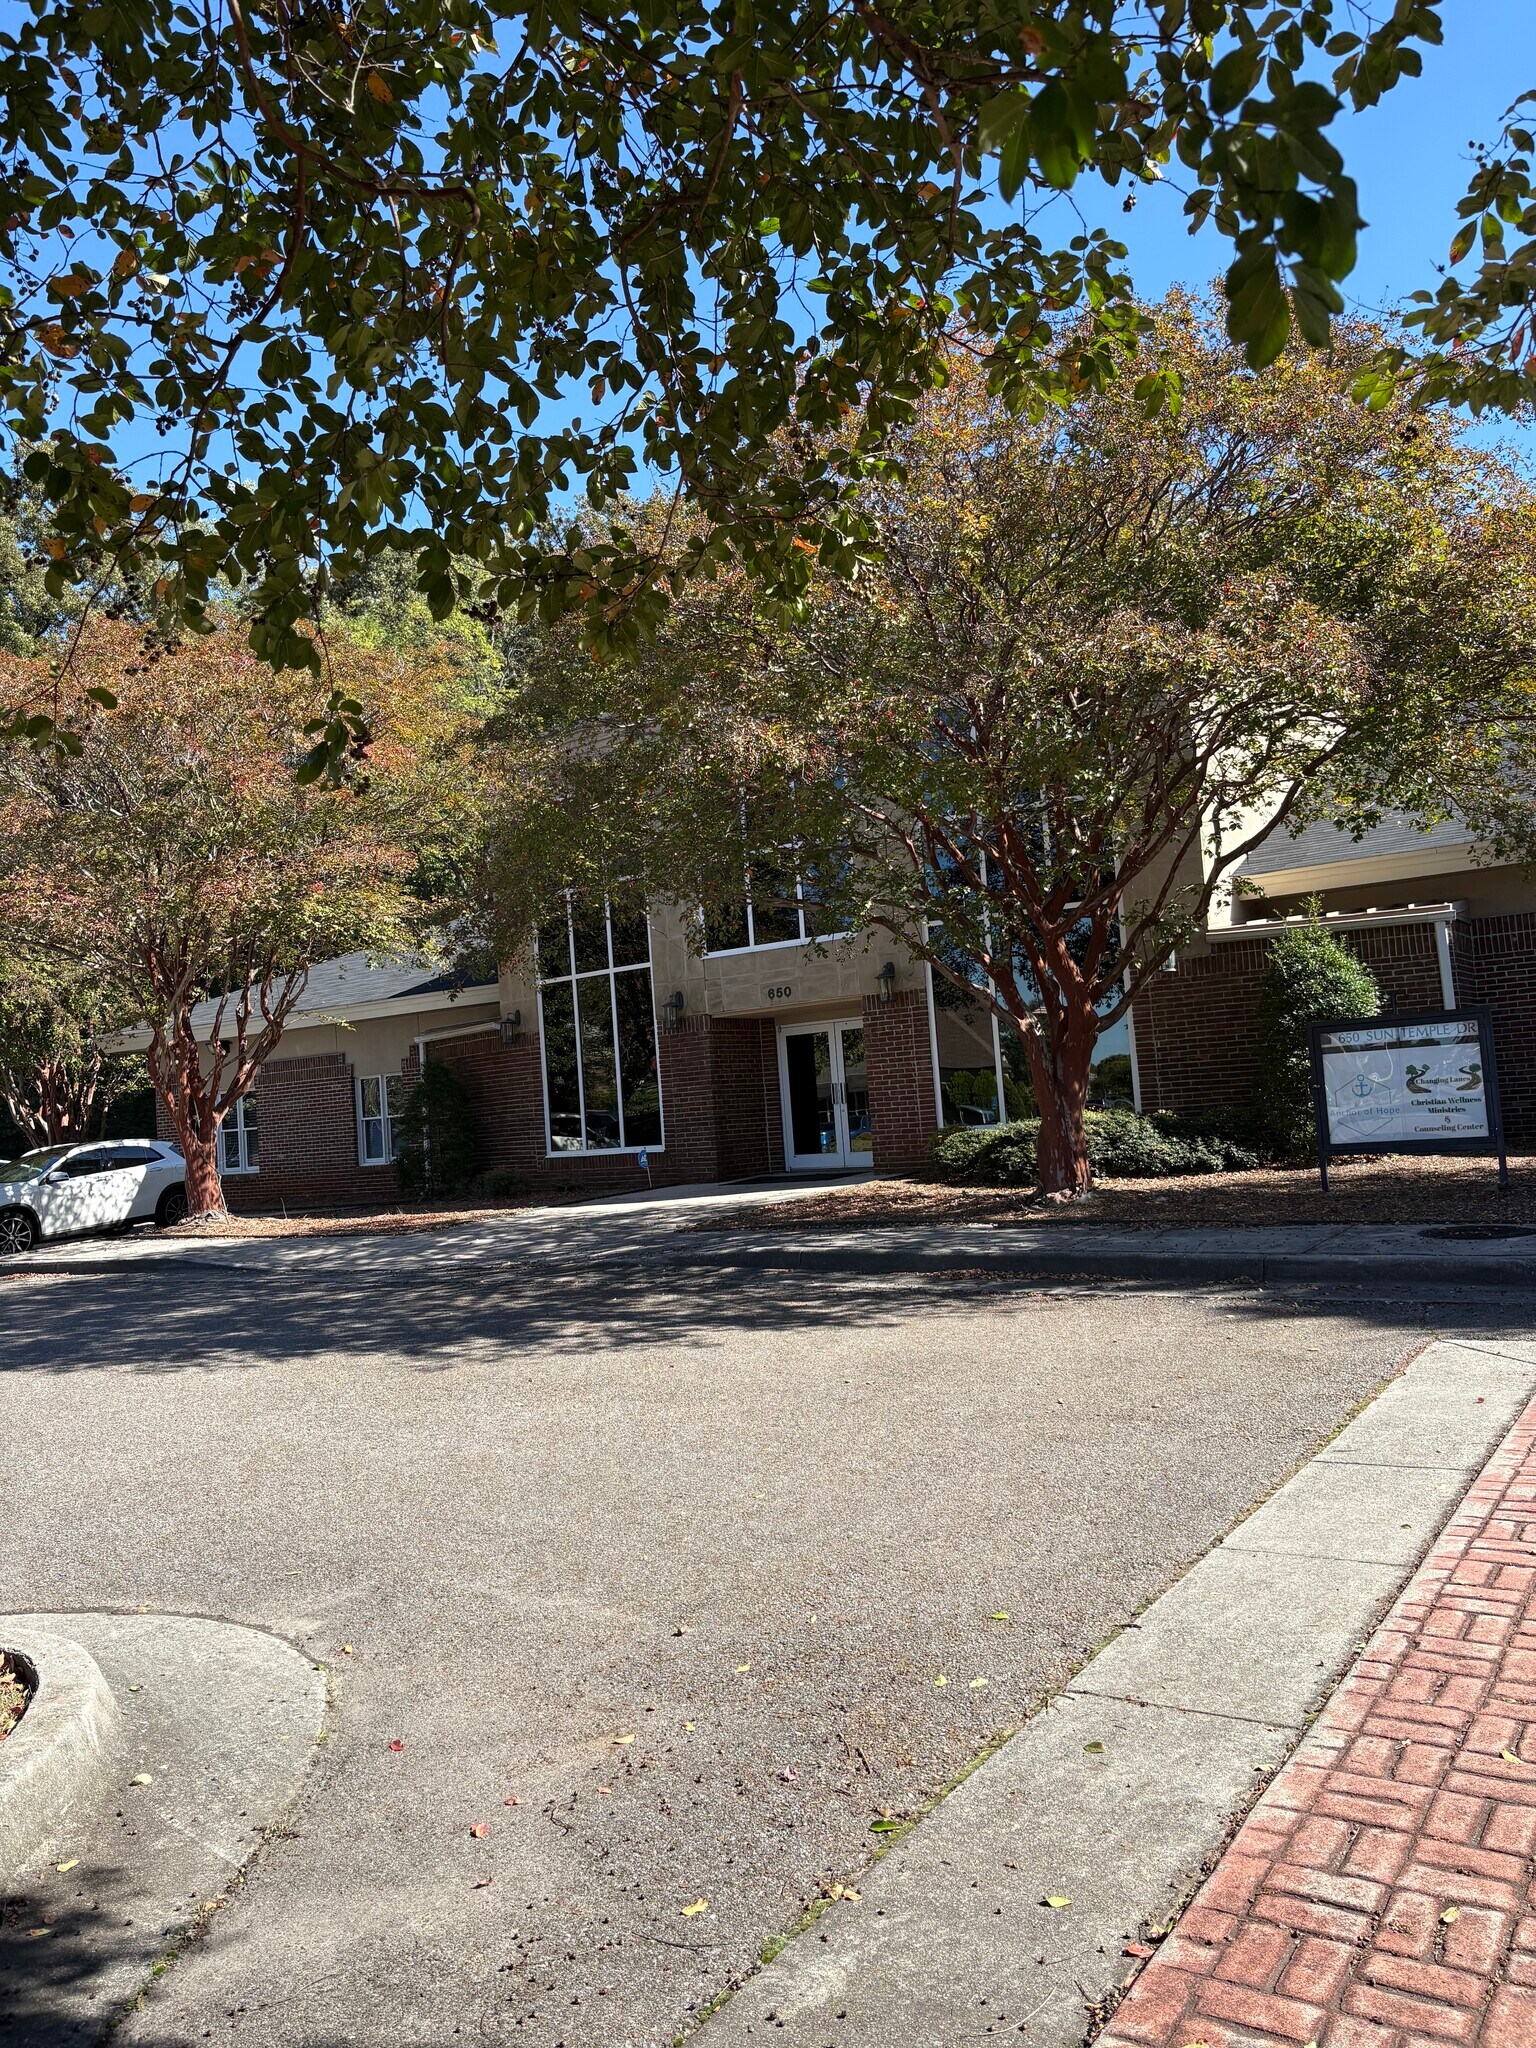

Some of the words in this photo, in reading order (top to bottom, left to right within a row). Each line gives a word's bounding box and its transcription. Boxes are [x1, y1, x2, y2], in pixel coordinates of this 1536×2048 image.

[768, 986, 792, 1000] 650
[1338, 1032, 1361, 1045] 650
[1366, 1029, 1394, 1042] SUN
[1402, 1024, 1450, 1039] TEMPLE
[1457, 1022, 1477, 1034] DR
[1415, 1077, 1449, 1085] Changing
[1411, 1098, 1447, 1106] Christian
[1448, 1096, 1482, 1104] Wellness
[1330, 1109, 1361, 1117] Anchor
[1376, 1107, 1400, 1115] Hope
[1428, 1106, 1466, 1114] Ministries
[1444, 1115, 1451, 1123] &
[1414, 1124, 1456, 1133] Counseling
[1457, 1123, 1484, 1131] Center
